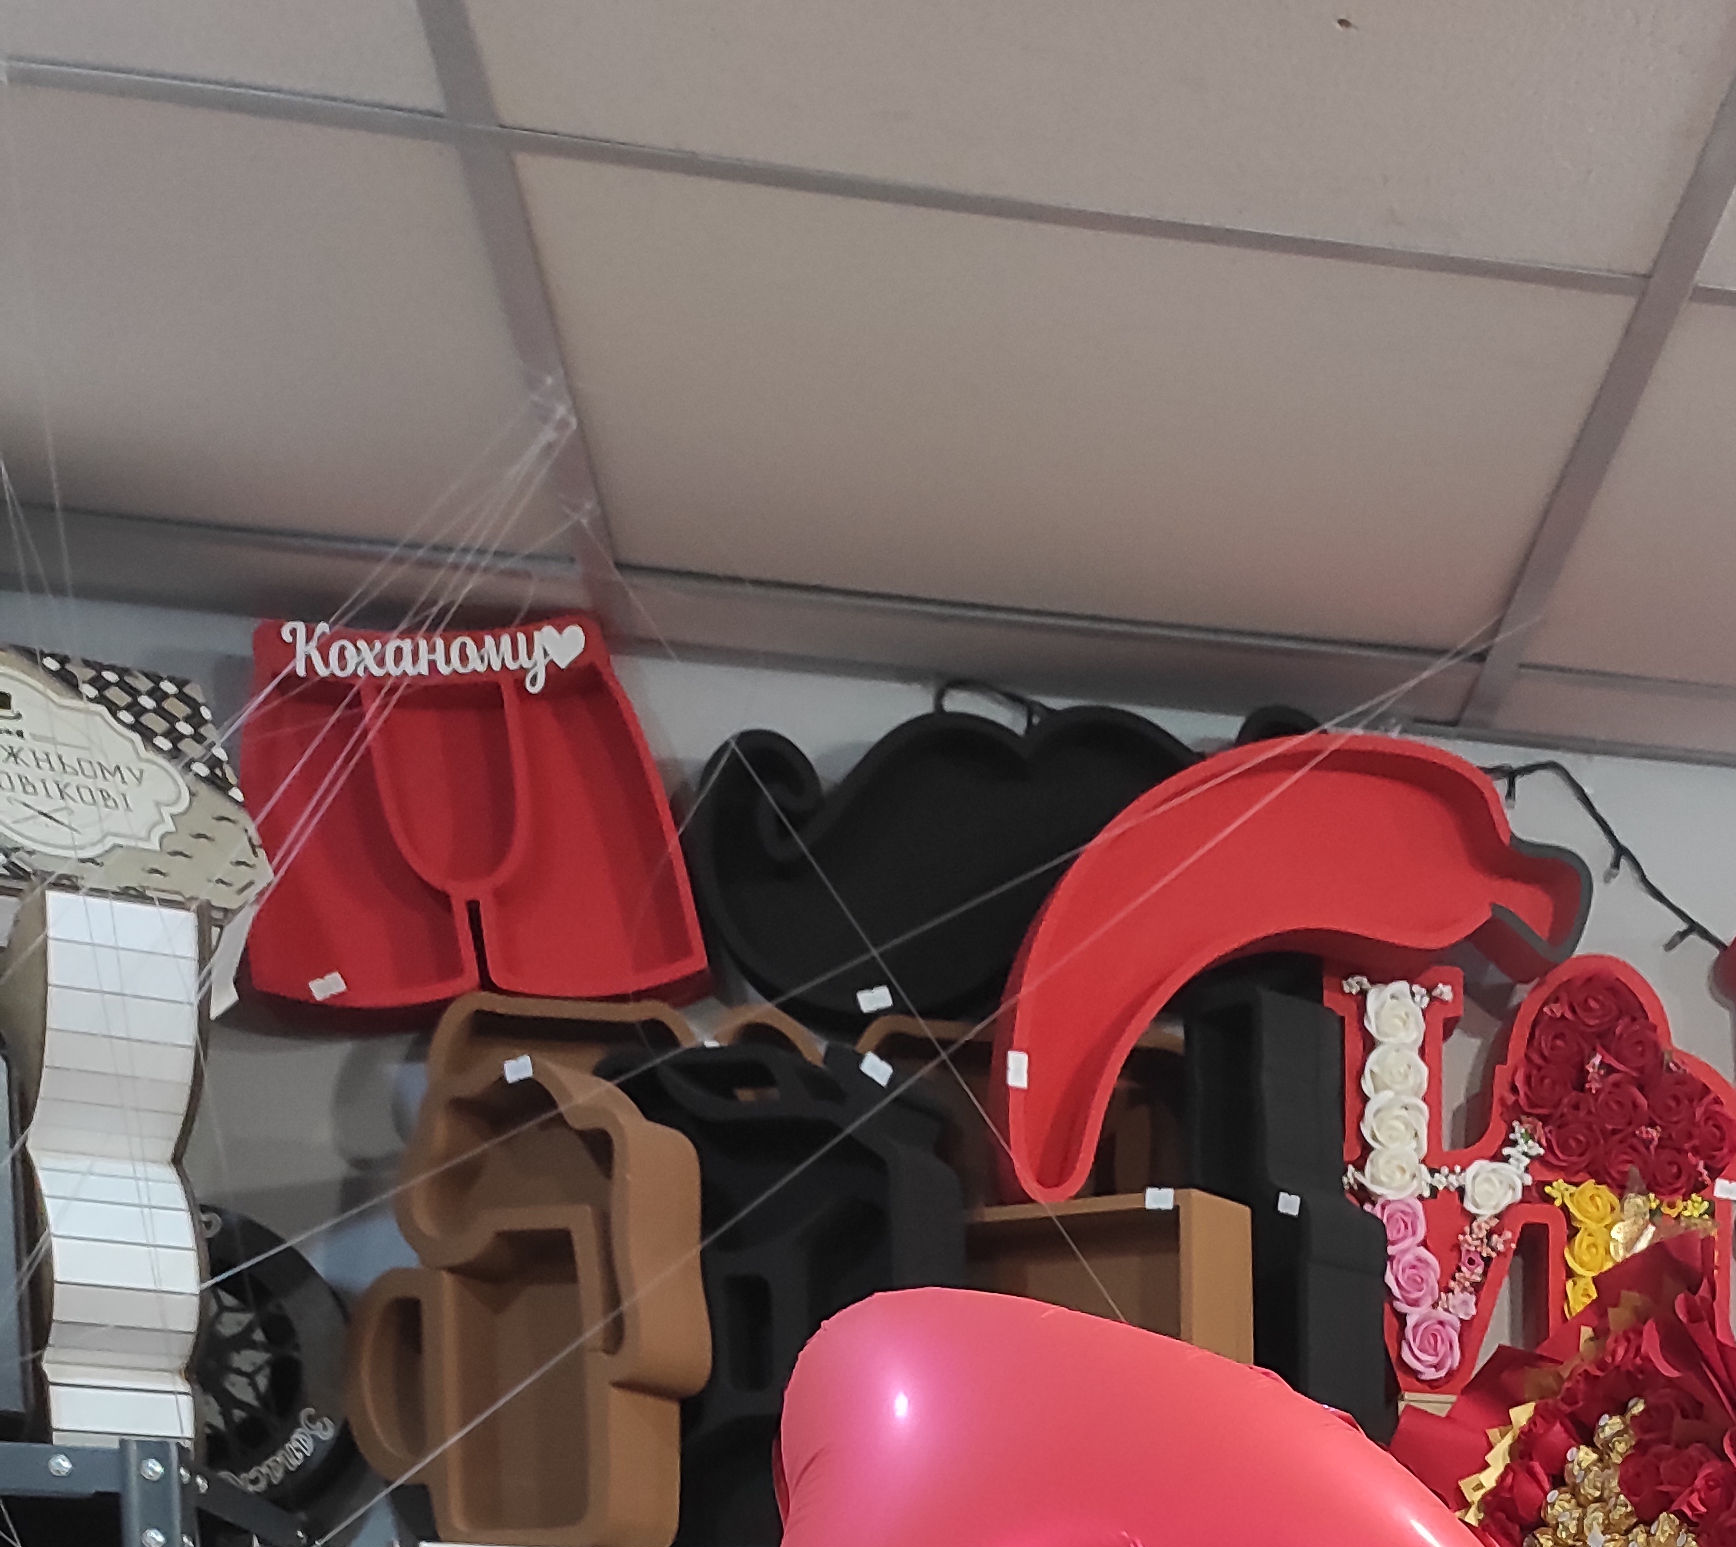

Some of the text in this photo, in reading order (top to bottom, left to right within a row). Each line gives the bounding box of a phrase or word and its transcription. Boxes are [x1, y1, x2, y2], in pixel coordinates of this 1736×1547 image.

[280, 620, 557, 694] Коханому
[0, 744, 145, 786] ЖНЬОМУ
[0, 771, 133, 813] ОВІКОВІ
